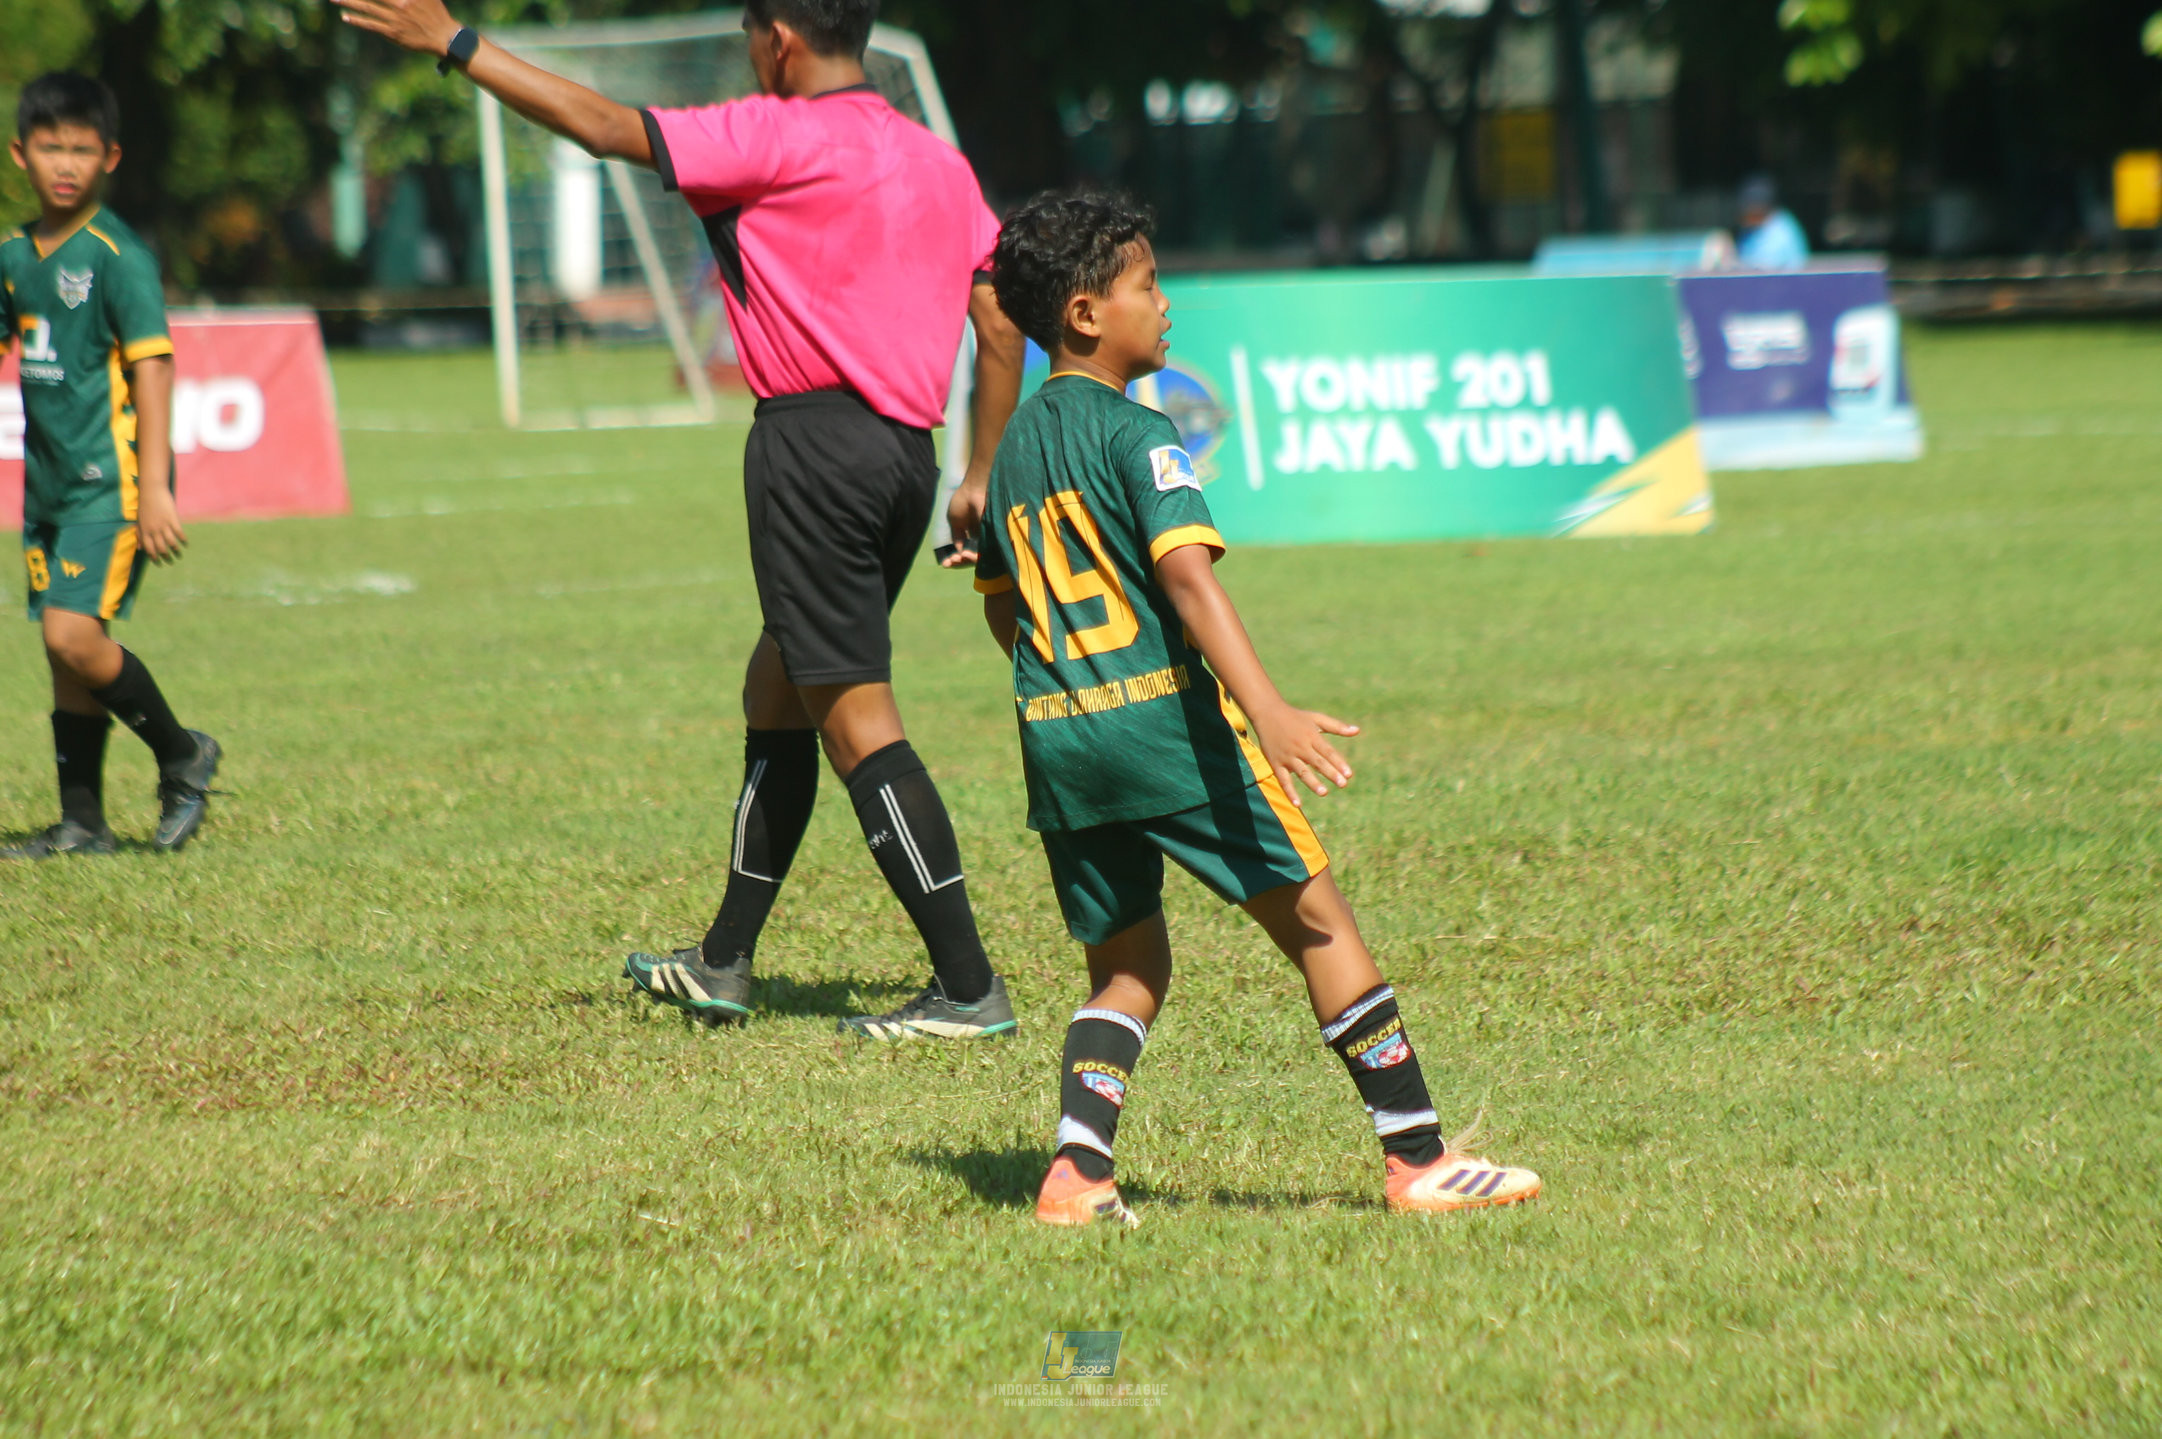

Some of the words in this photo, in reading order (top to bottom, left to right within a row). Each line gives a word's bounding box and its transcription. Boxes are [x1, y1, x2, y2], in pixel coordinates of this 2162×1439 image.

[1261, 354, 1439, 414] YONIF
[1452, 350, 1552, 409] 201
[1273, 415, 1418, 474] JAYA
[1424, 406, 1636, 470] YUDHA
[1007, 490, 1140, 664] 19
[1026, 691, 1069, 722] BINTANG
[1124, 664, 1191, 704] INDONESIA
[1072, 1061, 1129, 1085] SOCCE
